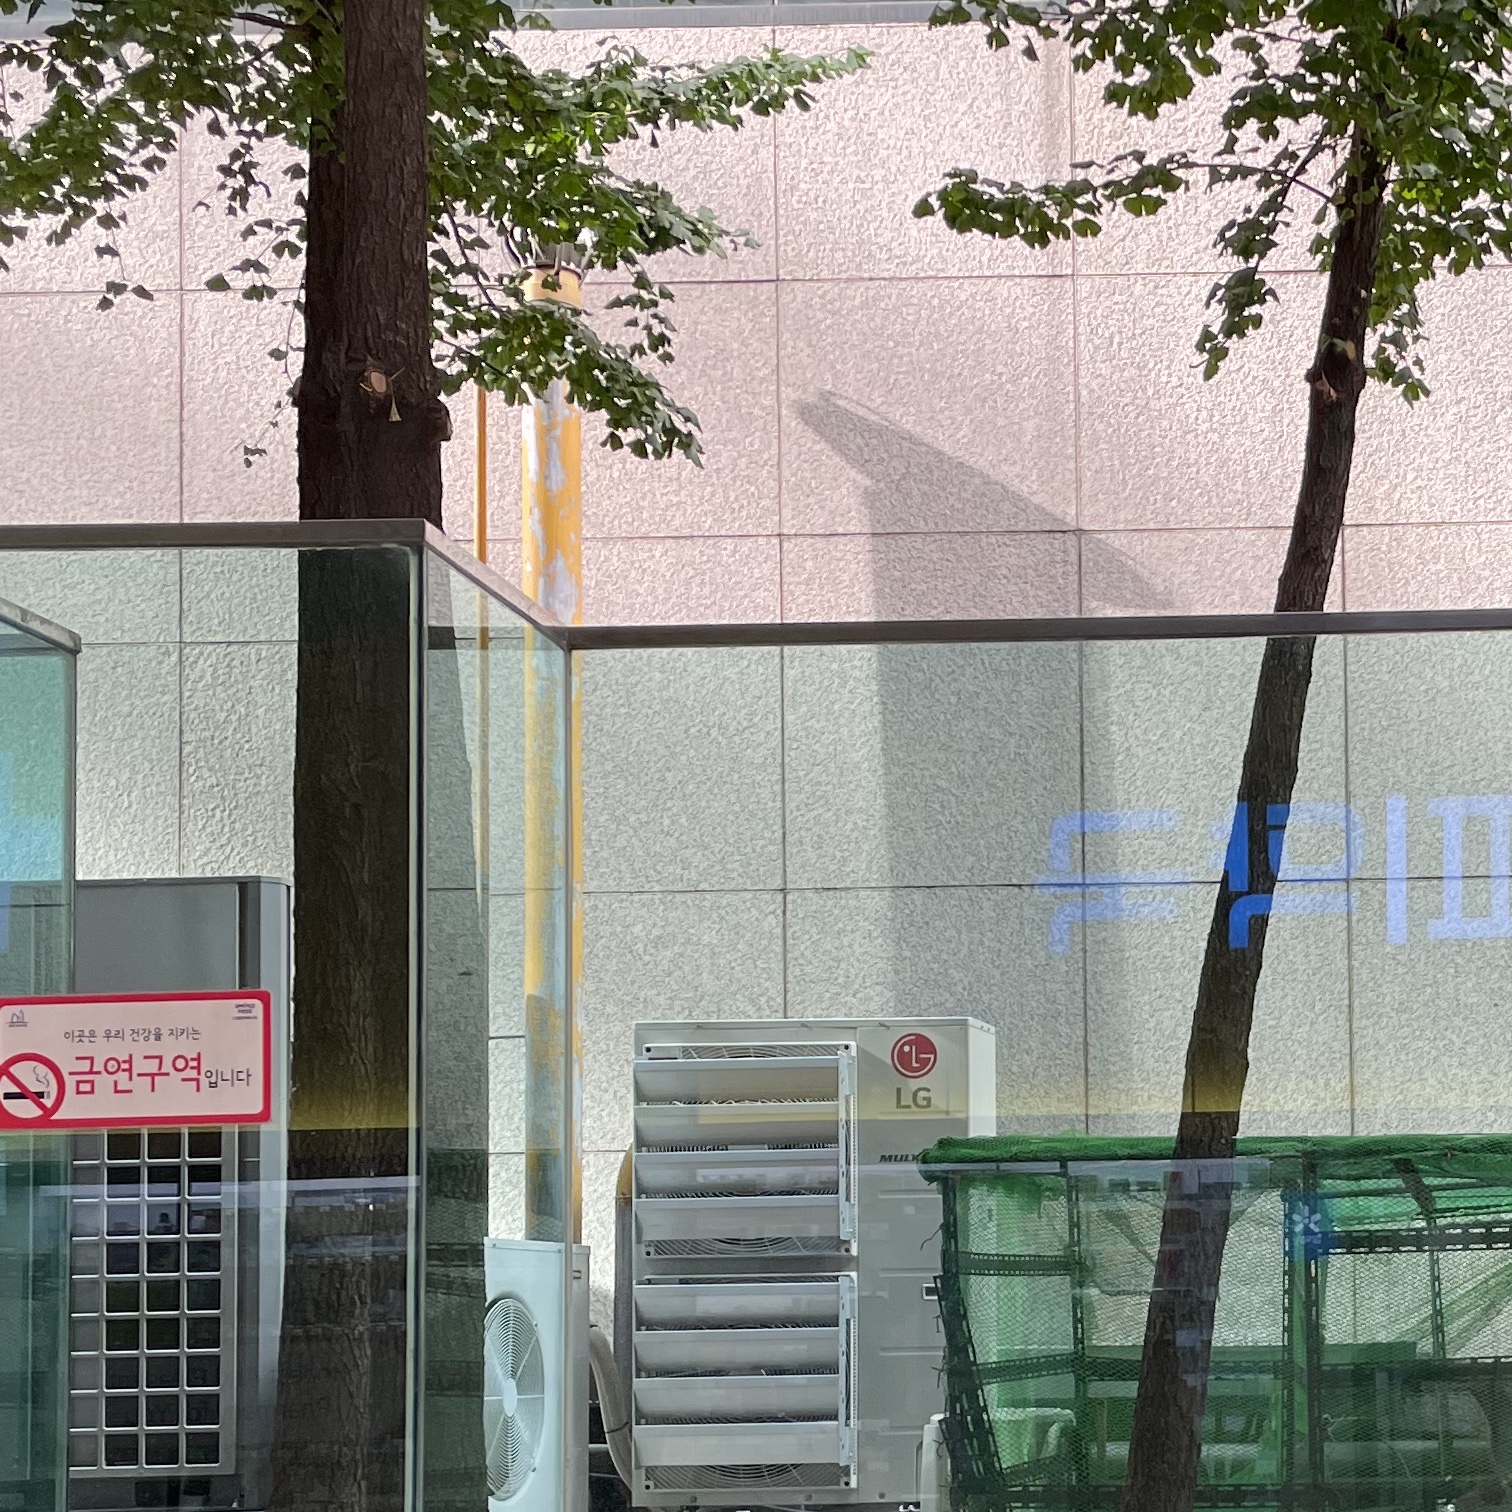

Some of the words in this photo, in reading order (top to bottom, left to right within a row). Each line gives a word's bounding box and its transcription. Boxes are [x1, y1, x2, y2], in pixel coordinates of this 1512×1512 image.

[64, 1028, 97, 1044] 이곳은
[102, 1028, 125, 1043] 우리
[129, 1027, 163, 1043] 건강을
[168, 1026, 201, 1041] 지키는
[896, 1087, 932, 1109] LG
